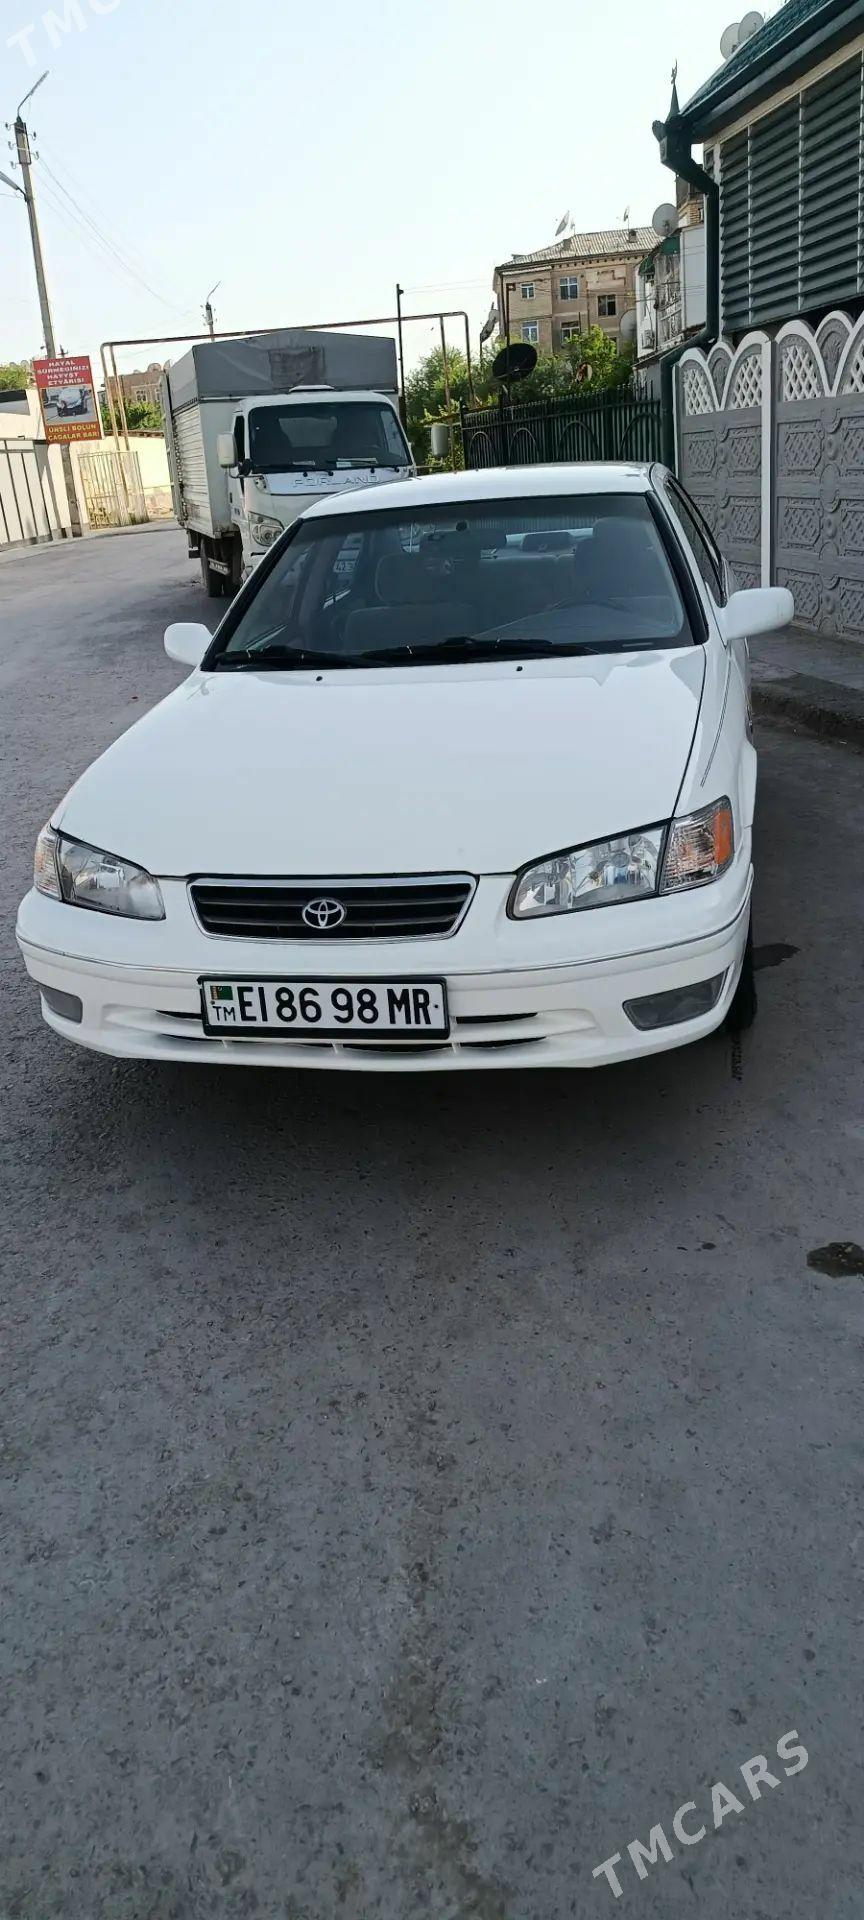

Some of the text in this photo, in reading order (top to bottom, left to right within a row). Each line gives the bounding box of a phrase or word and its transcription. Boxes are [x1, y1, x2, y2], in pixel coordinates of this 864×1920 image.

[292, 475, 380, 488] FORLAND
[212, 986, 432, 1025] TM EI 86 98 MR
